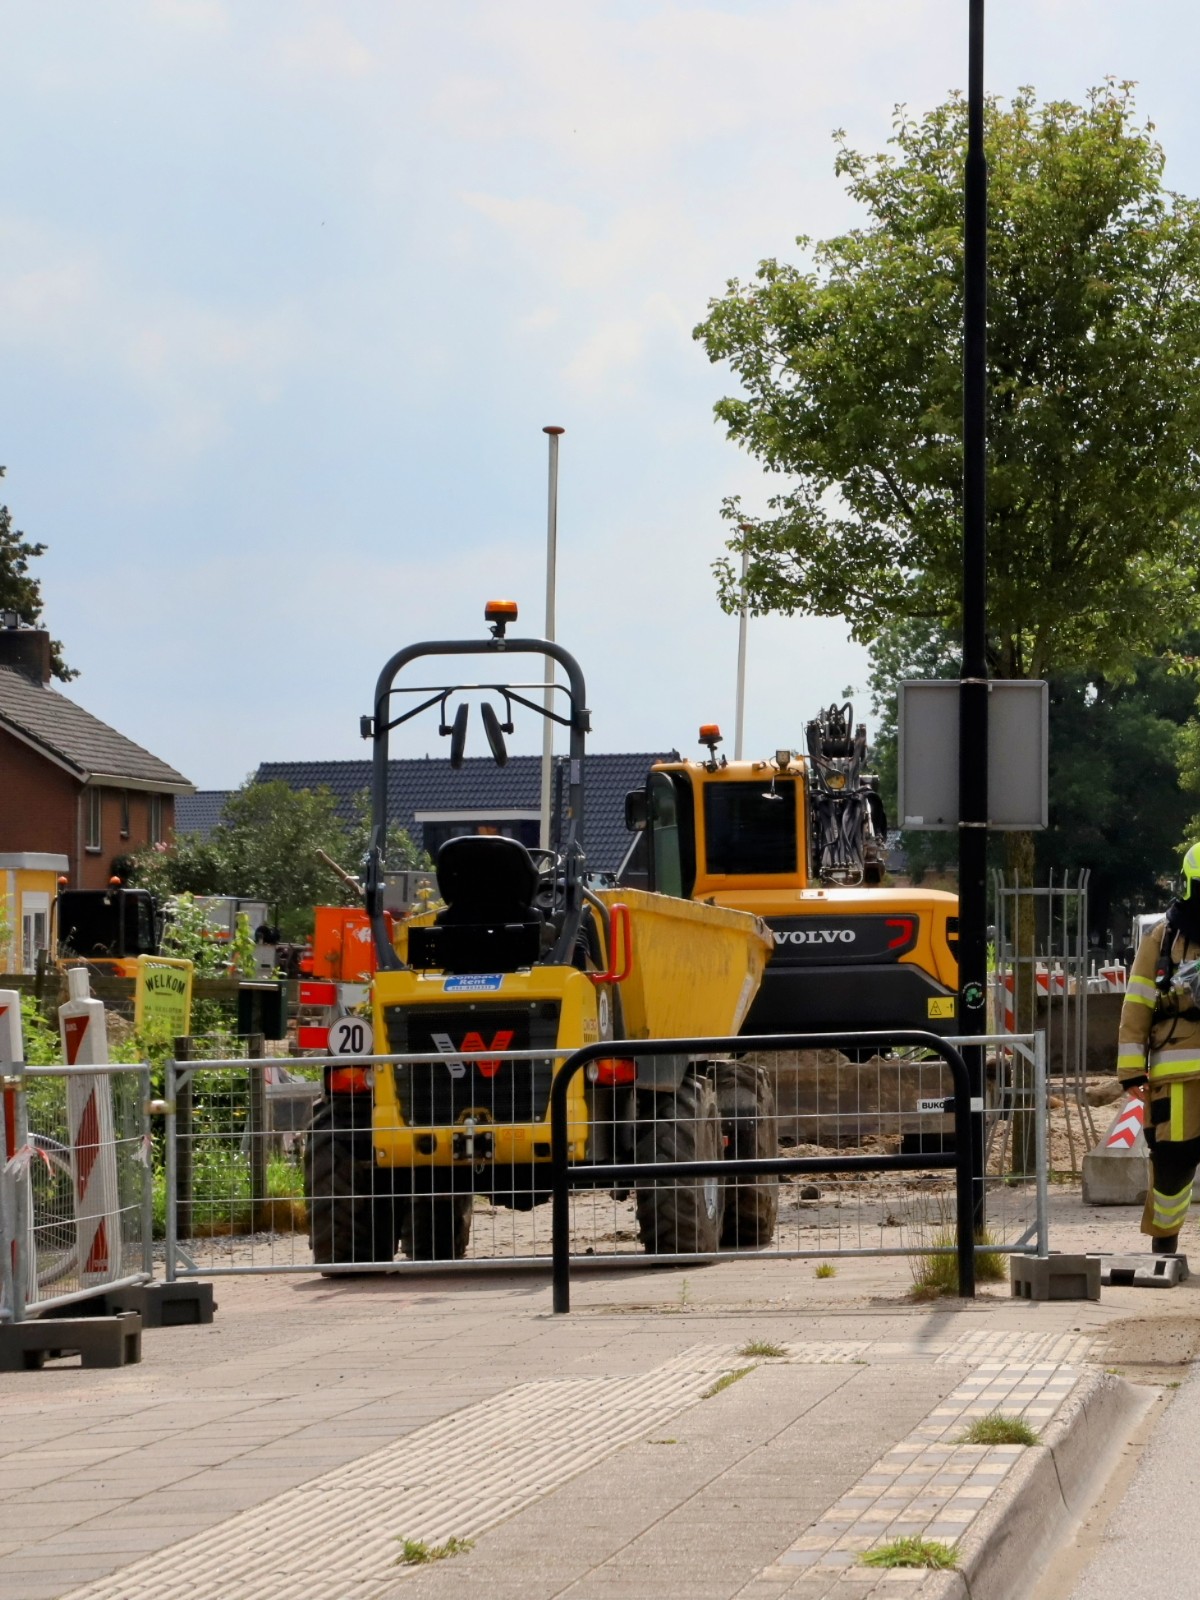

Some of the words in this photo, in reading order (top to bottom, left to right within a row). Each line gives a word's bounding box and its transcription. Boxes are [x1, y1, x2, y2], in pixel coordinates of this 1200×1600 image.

[773, 930, 856, 944] VOLVO
[146, 974, 186, 995] WELKOM
[339, 1025, 364, 1053] 20
